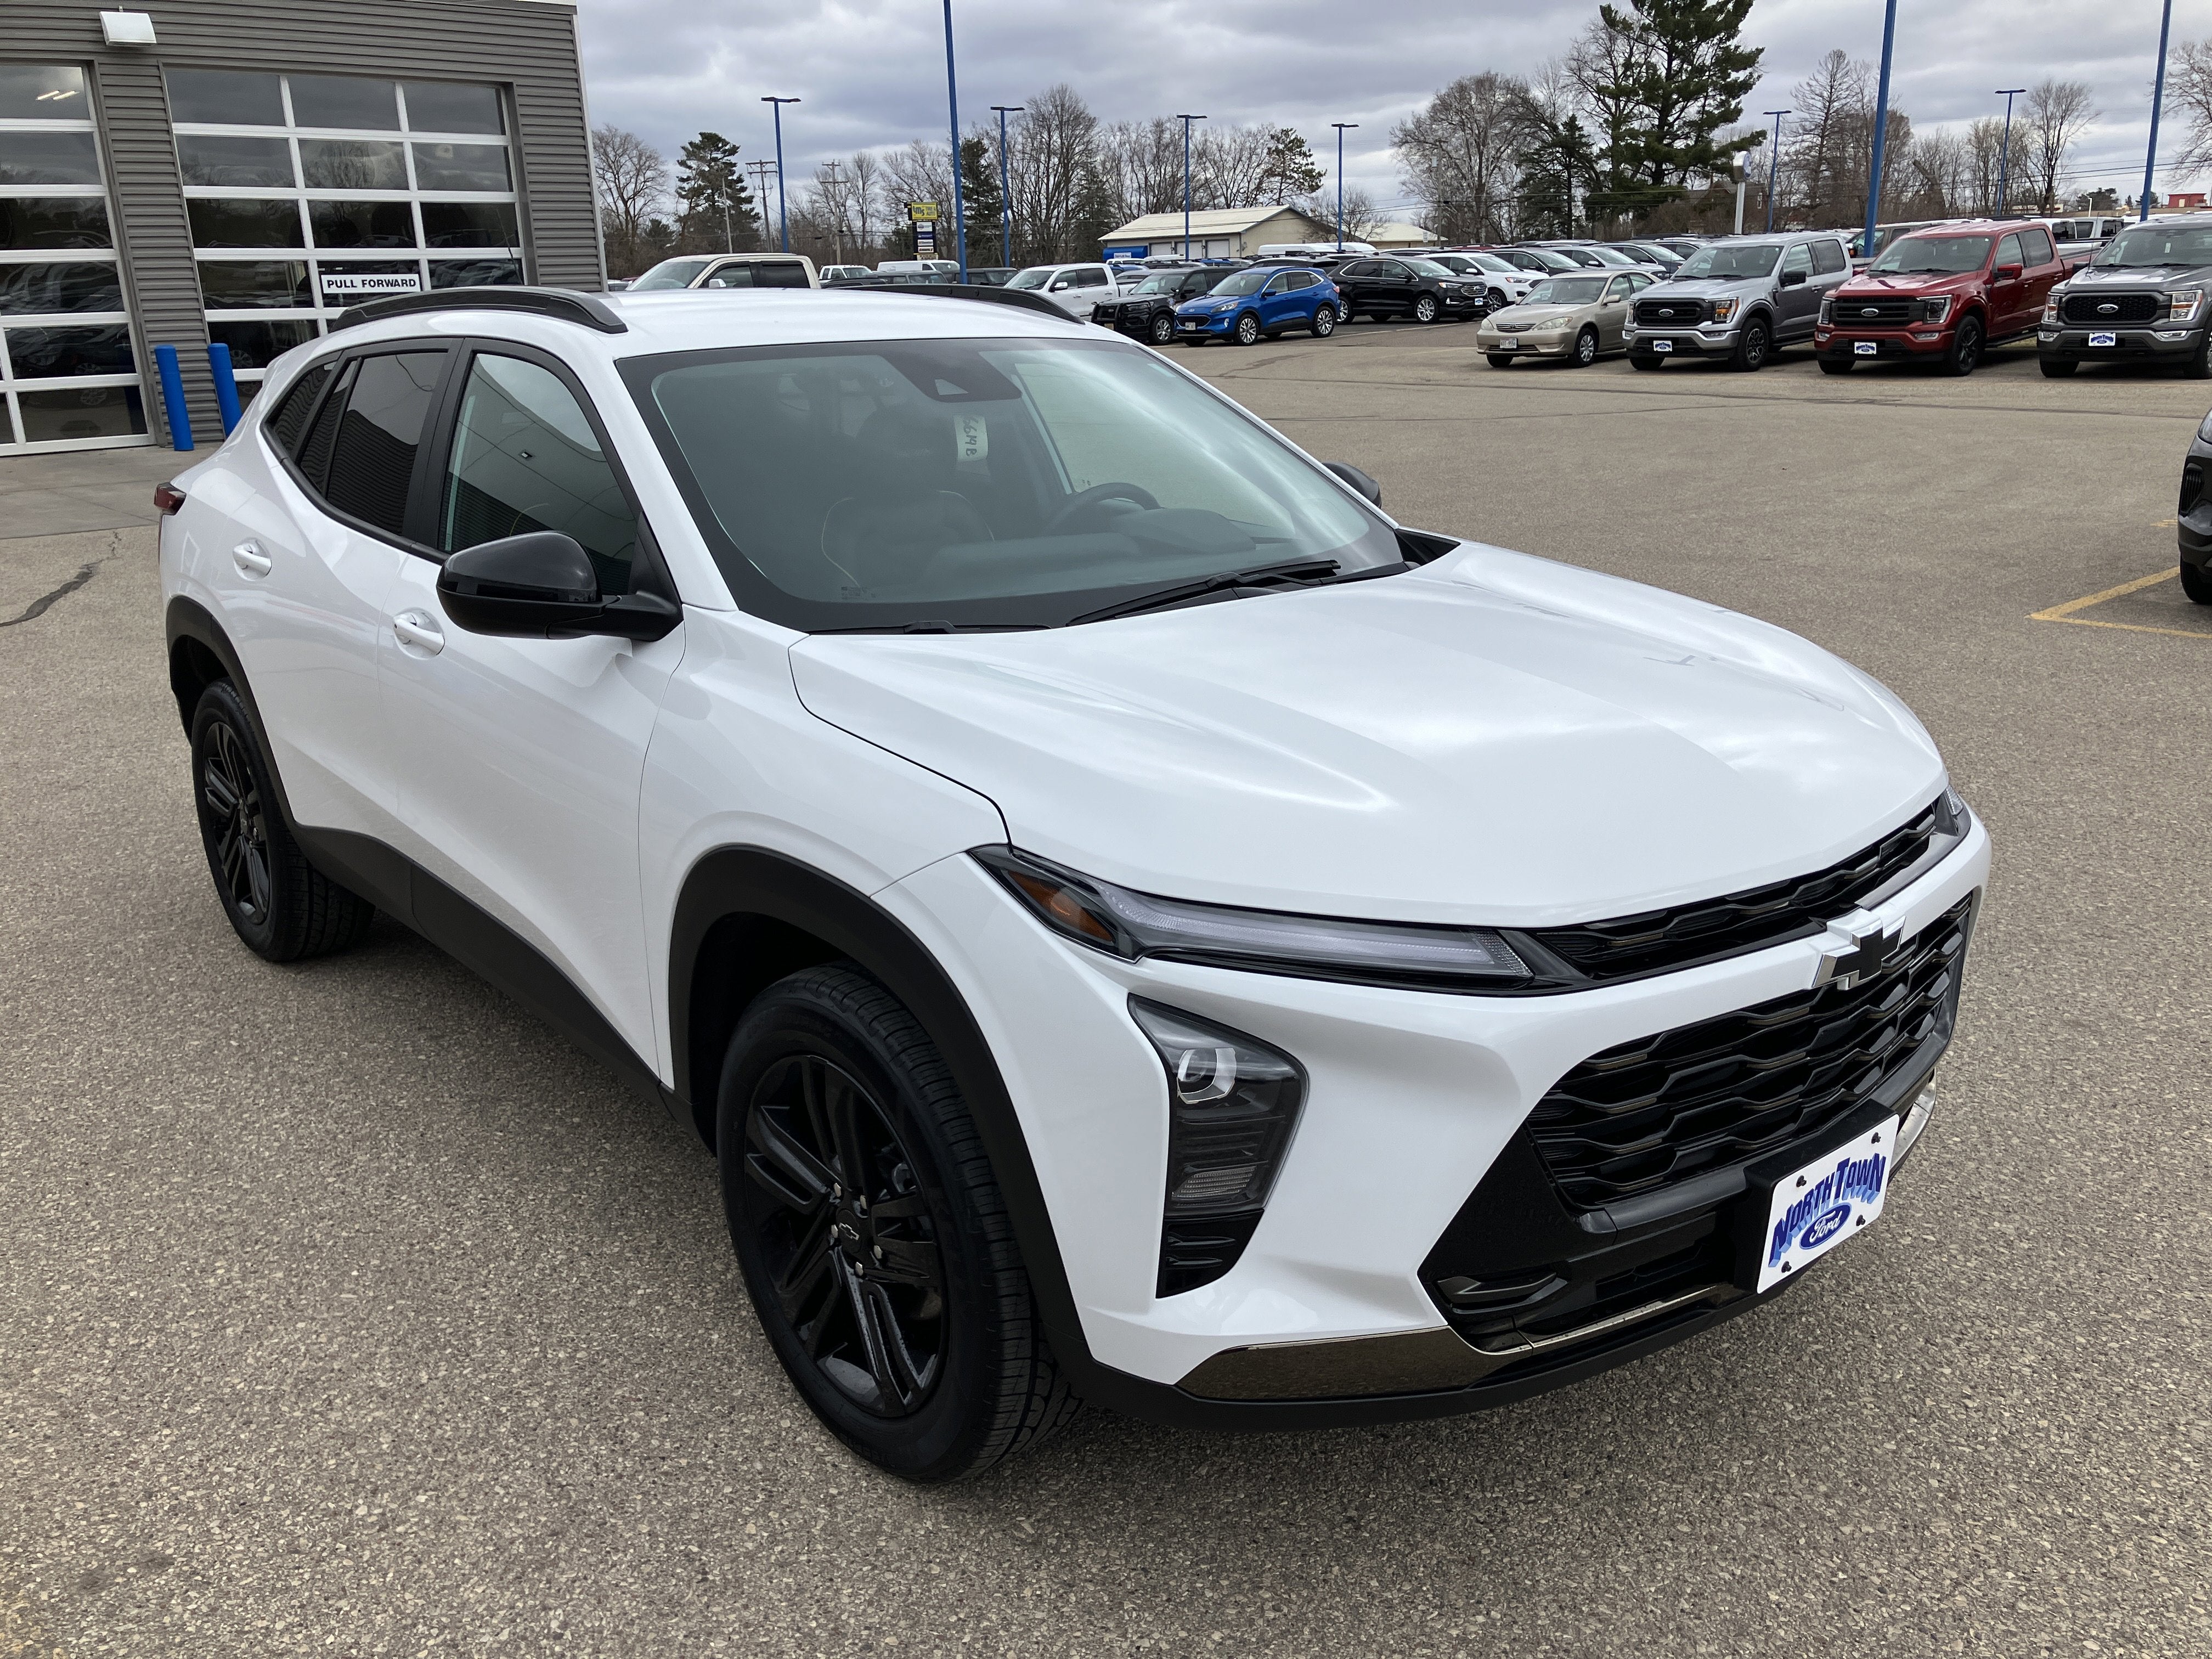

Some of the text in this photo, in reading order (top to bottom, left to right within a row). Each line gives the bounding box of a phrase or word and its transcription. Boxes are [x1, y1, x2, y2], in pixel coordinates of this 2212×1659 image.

[326, 279, 416, 288] PULL FORWARD
[1809, 1210, 1843, 1243] Ford
